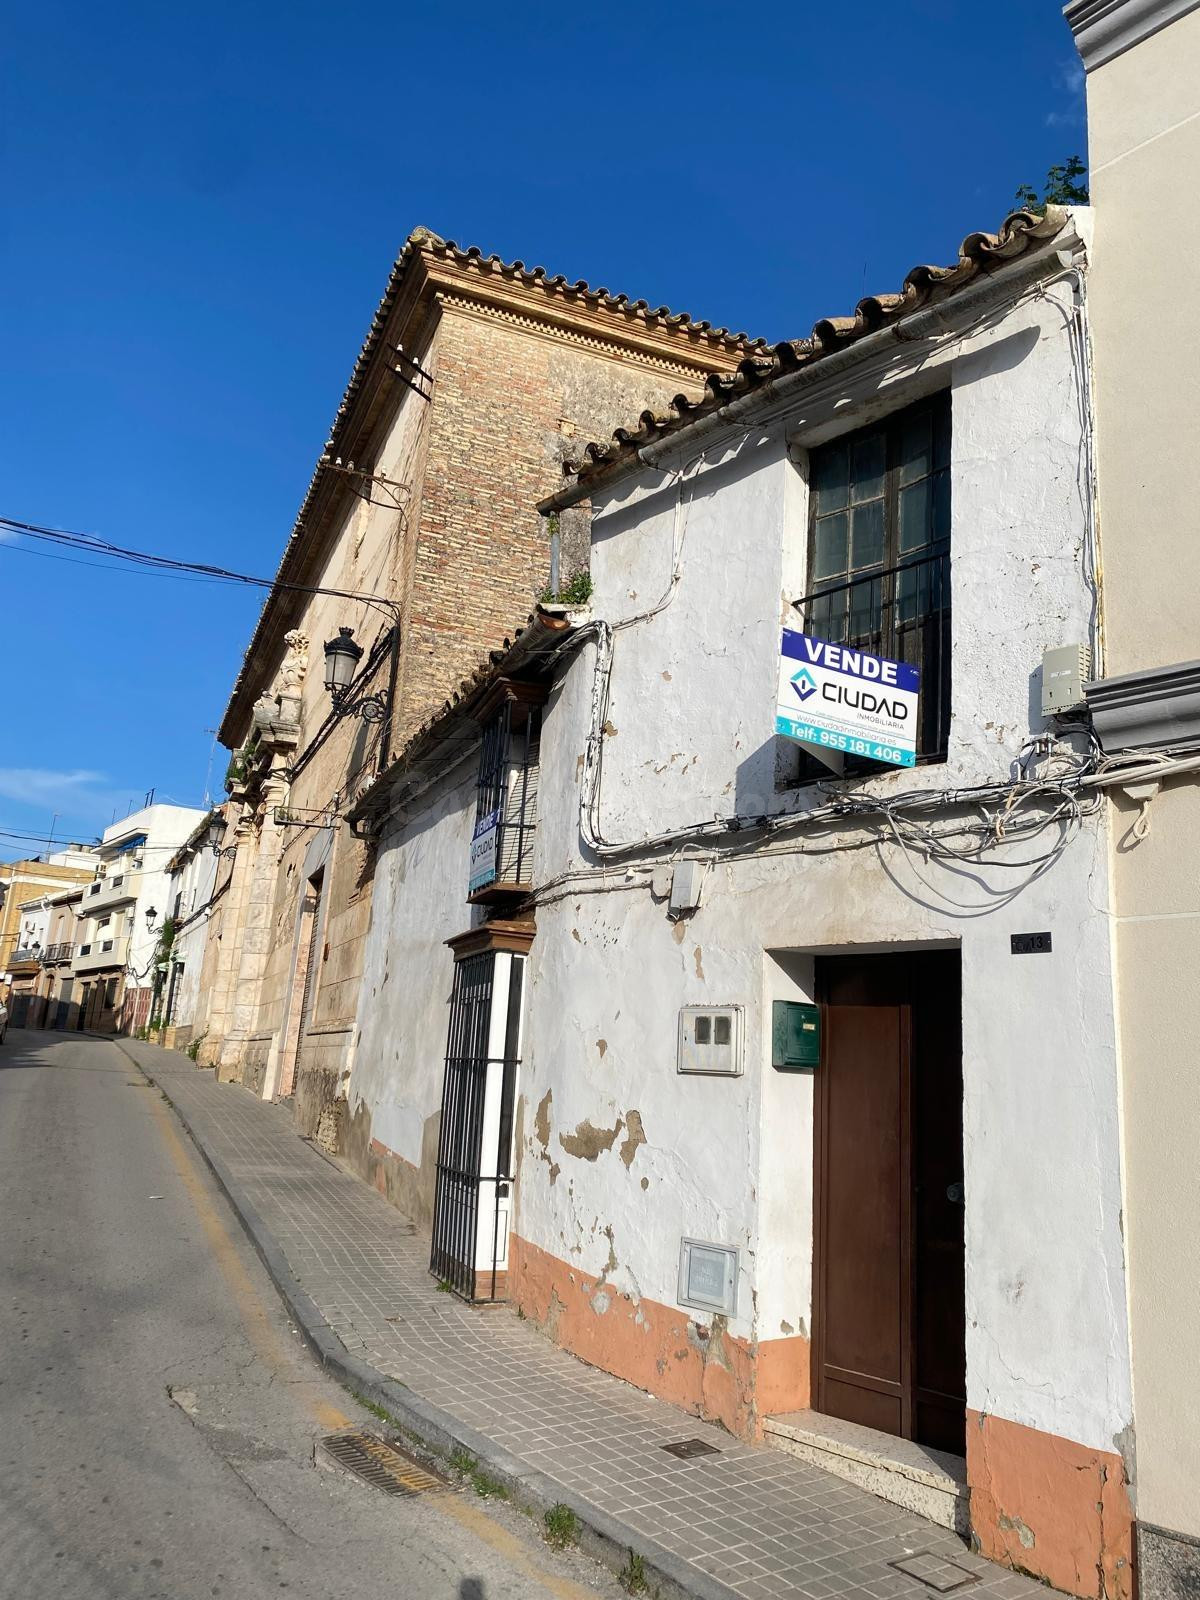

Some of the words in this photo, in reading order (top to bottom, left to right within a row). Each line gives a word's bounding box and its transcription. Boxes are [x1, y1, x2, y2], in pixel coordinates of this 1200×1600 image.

[804, 637, 898, 685] VENDE
[822, 682, 908, 720] CIUDAD
[796, 714, 897, 746] www.ciudadinmobiliaria.es
[857, 712, 905, 730] INMOBILIARIA
[790, 722, 817, 741] Telf:
[820, 731, 847, 749] 955
[849, 739, 871, 755] 181
[873, 746, 902, 762] 406
[476, 812, 494, 836] VENDE
[477, 837, 493, 855] CIUDAD
[1030, 935, 1042, 949] 13
